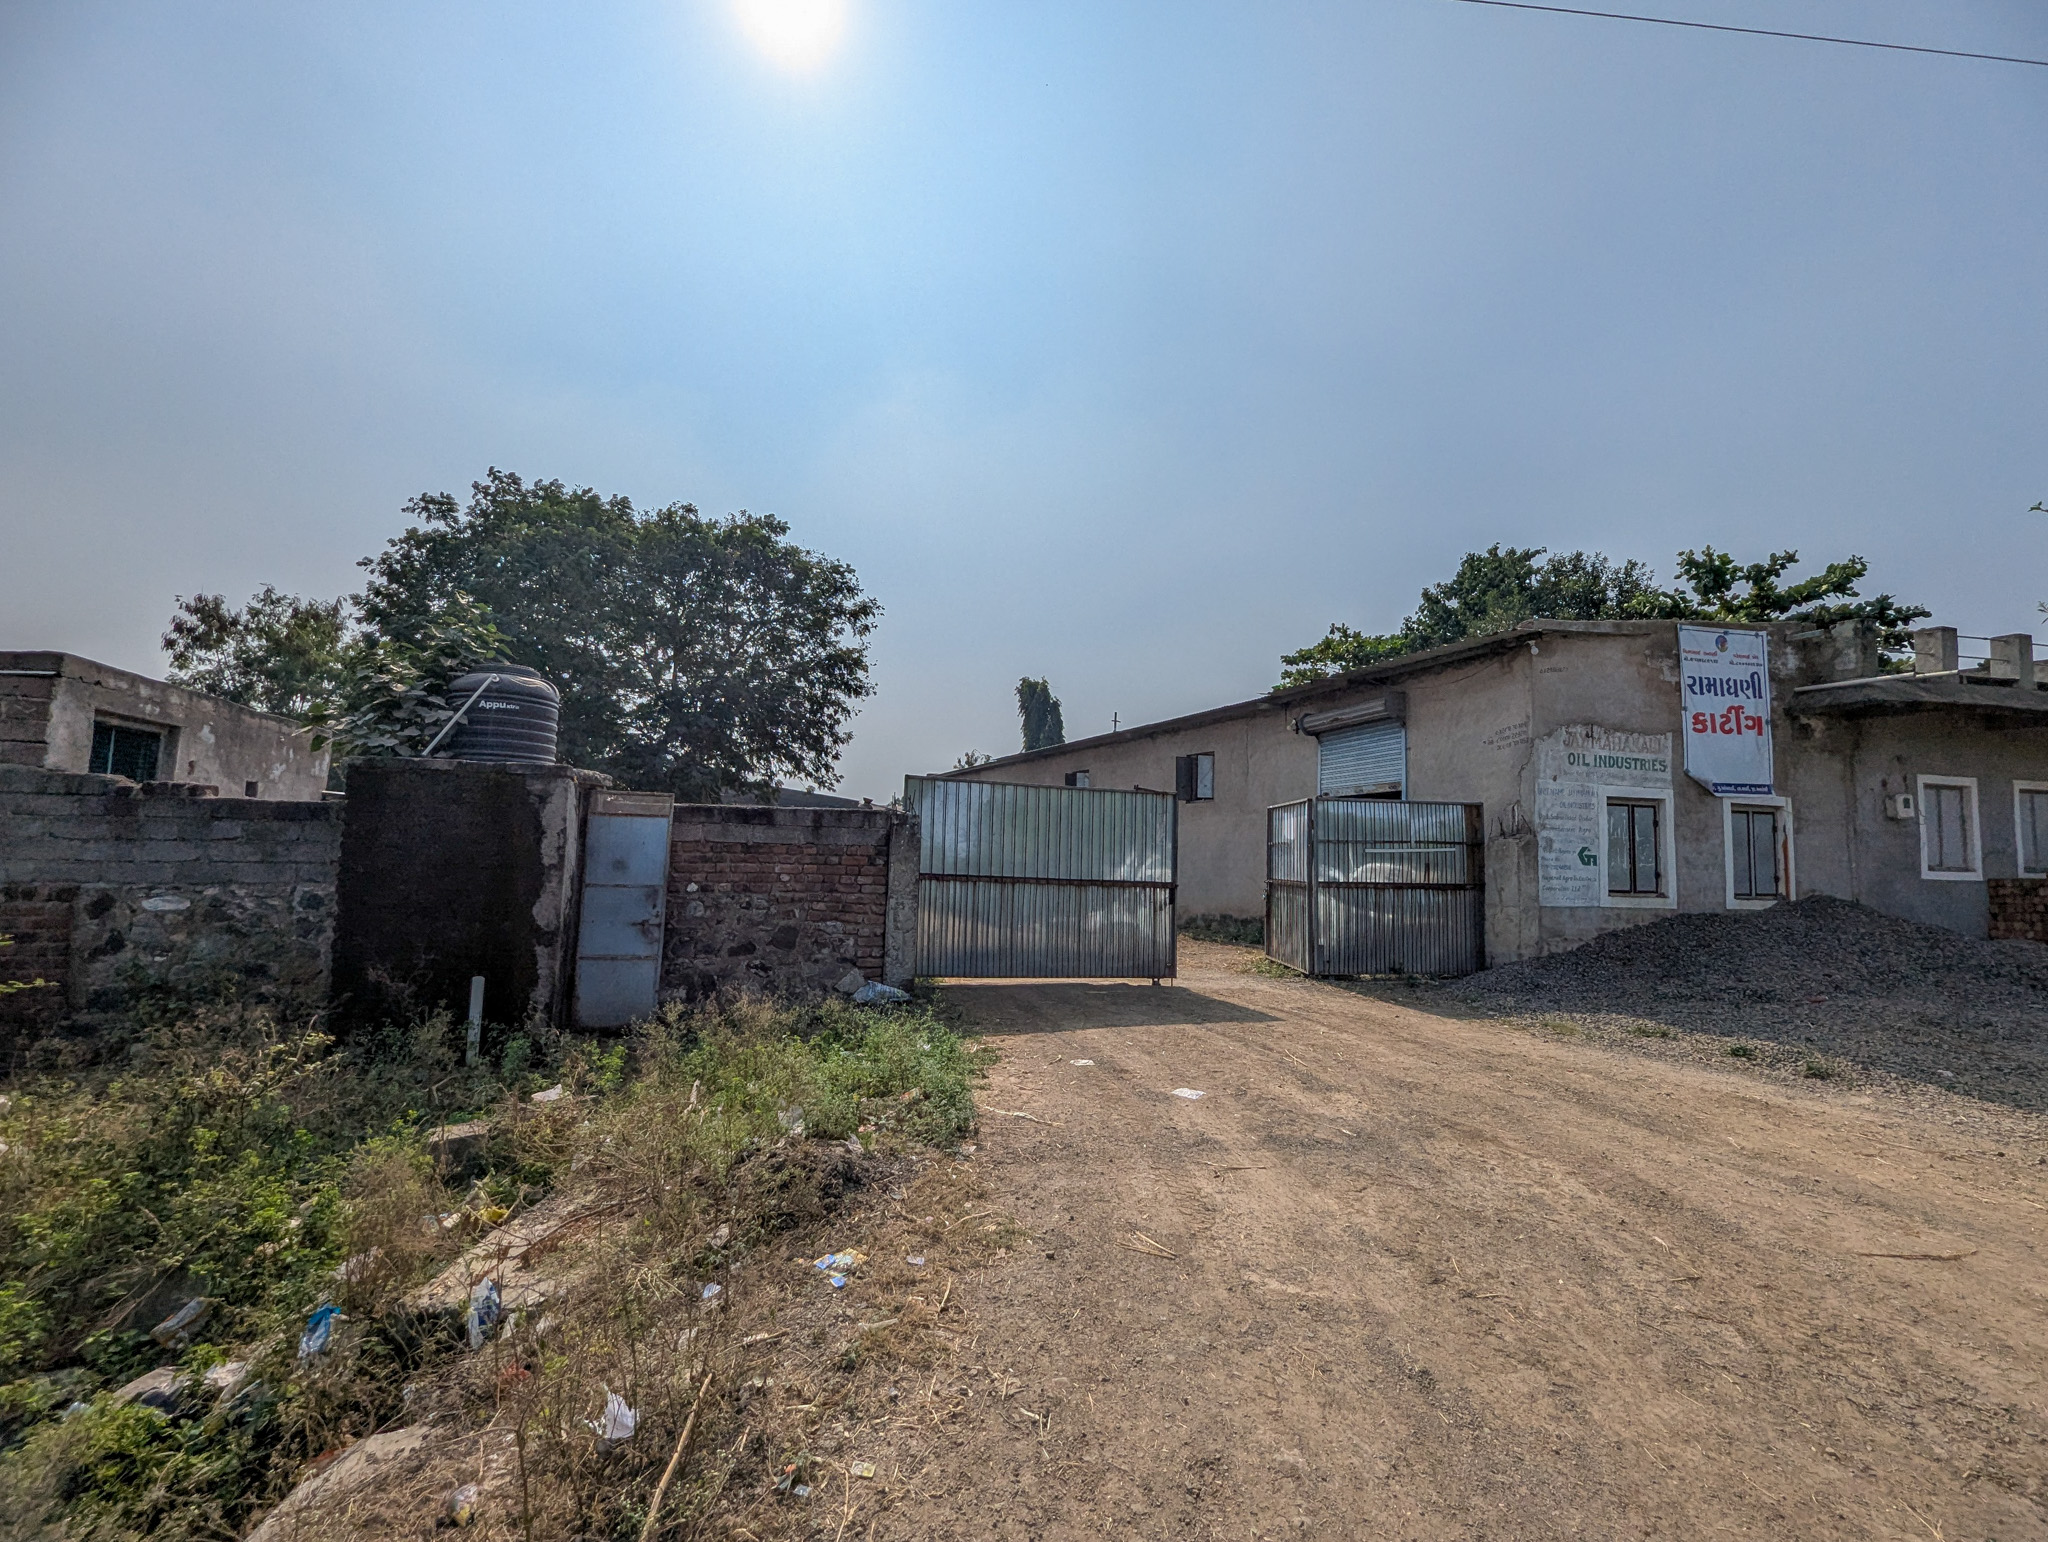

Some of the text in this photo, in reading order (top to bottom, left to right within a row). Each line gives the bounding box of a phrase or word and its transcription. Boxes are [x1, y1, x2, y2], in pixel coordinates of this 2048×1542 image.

[1687, 671, 1763, 700] રામાધણી
[478, 700, 506, 709] Appu
[1567, 752, 1668, 773] OIL INDUSTRIES
